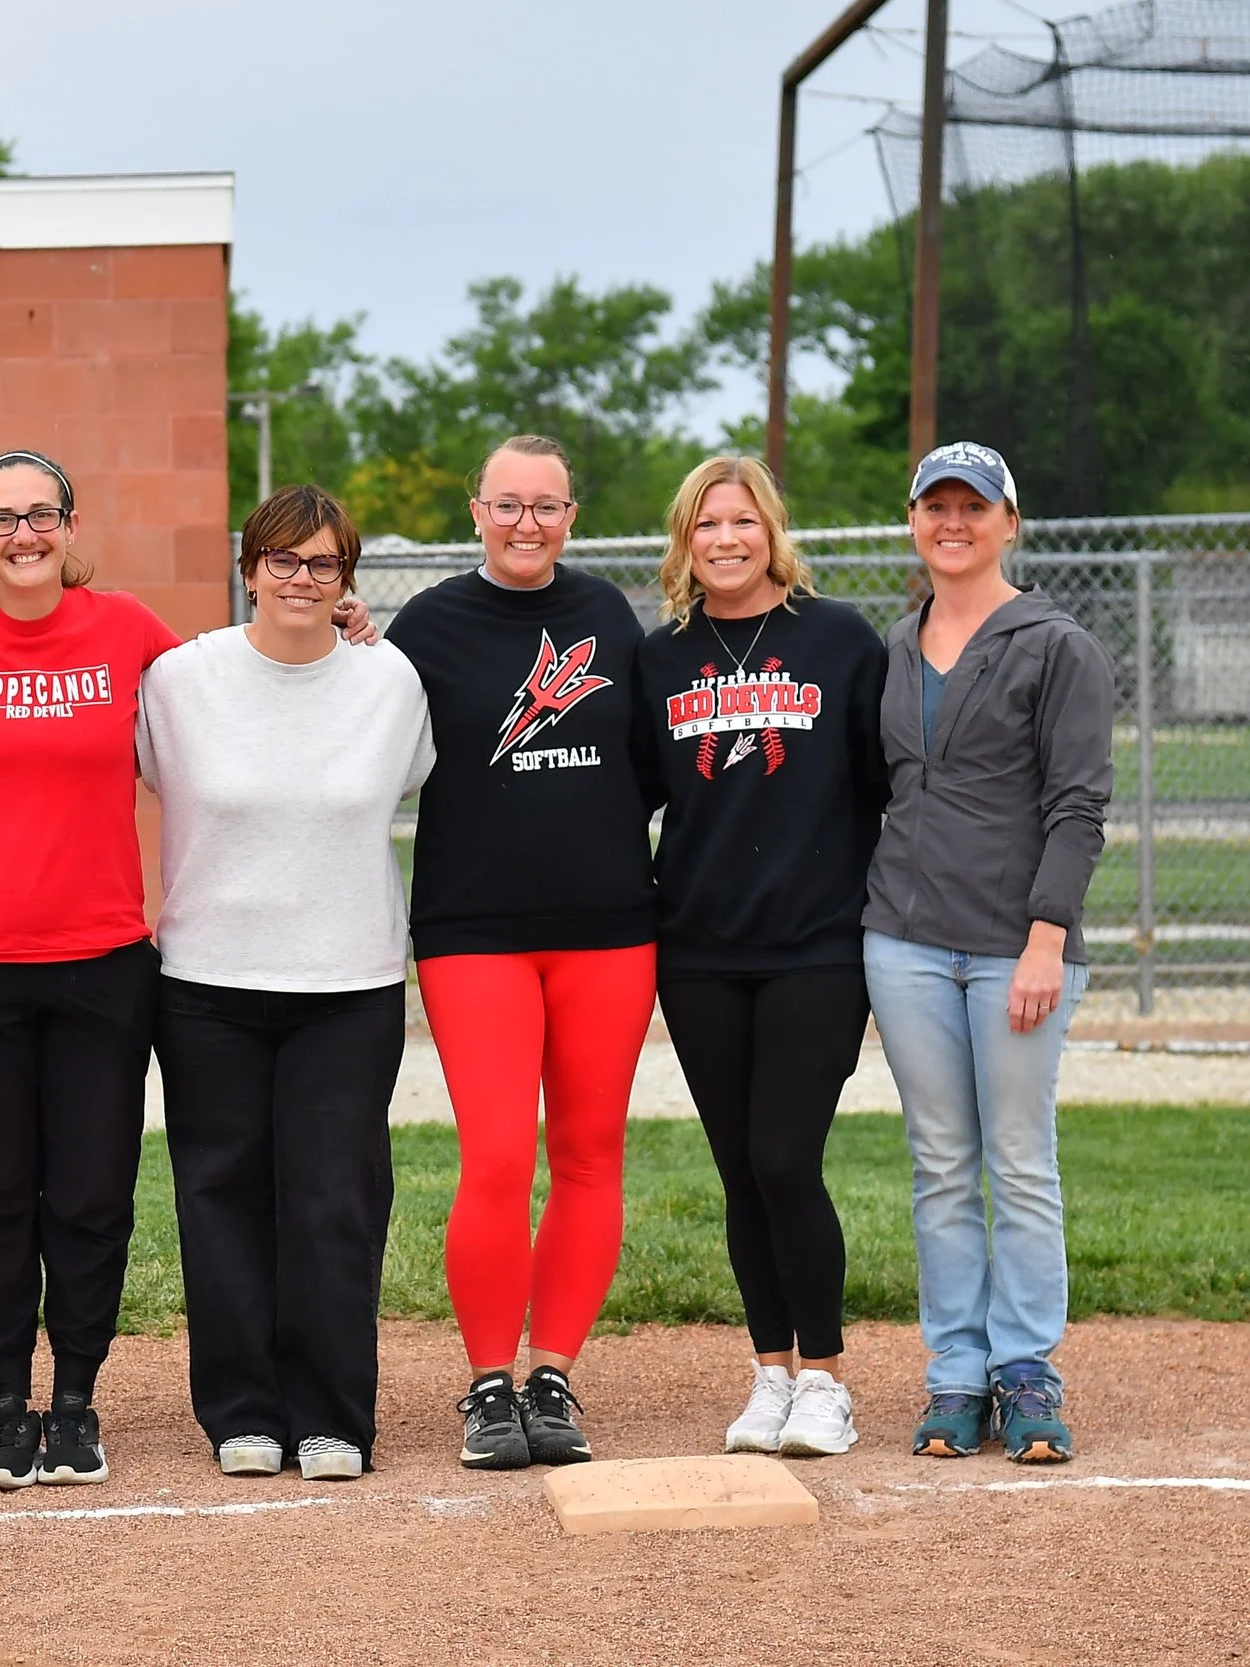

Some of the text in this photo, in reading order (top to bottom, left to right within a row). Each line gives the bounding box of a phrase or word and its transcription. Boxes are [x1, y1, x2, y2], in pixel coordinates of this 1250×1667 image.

[691, 671, 791, 690] TIPPECANOE
[5, 702, 74, 719] RED DEVILS
[667, 682, 823, 730] RED DEVILS
[678, 716, 807, 737] SOFTBALL
[511, 746, 601, 772] SOFTBALL
